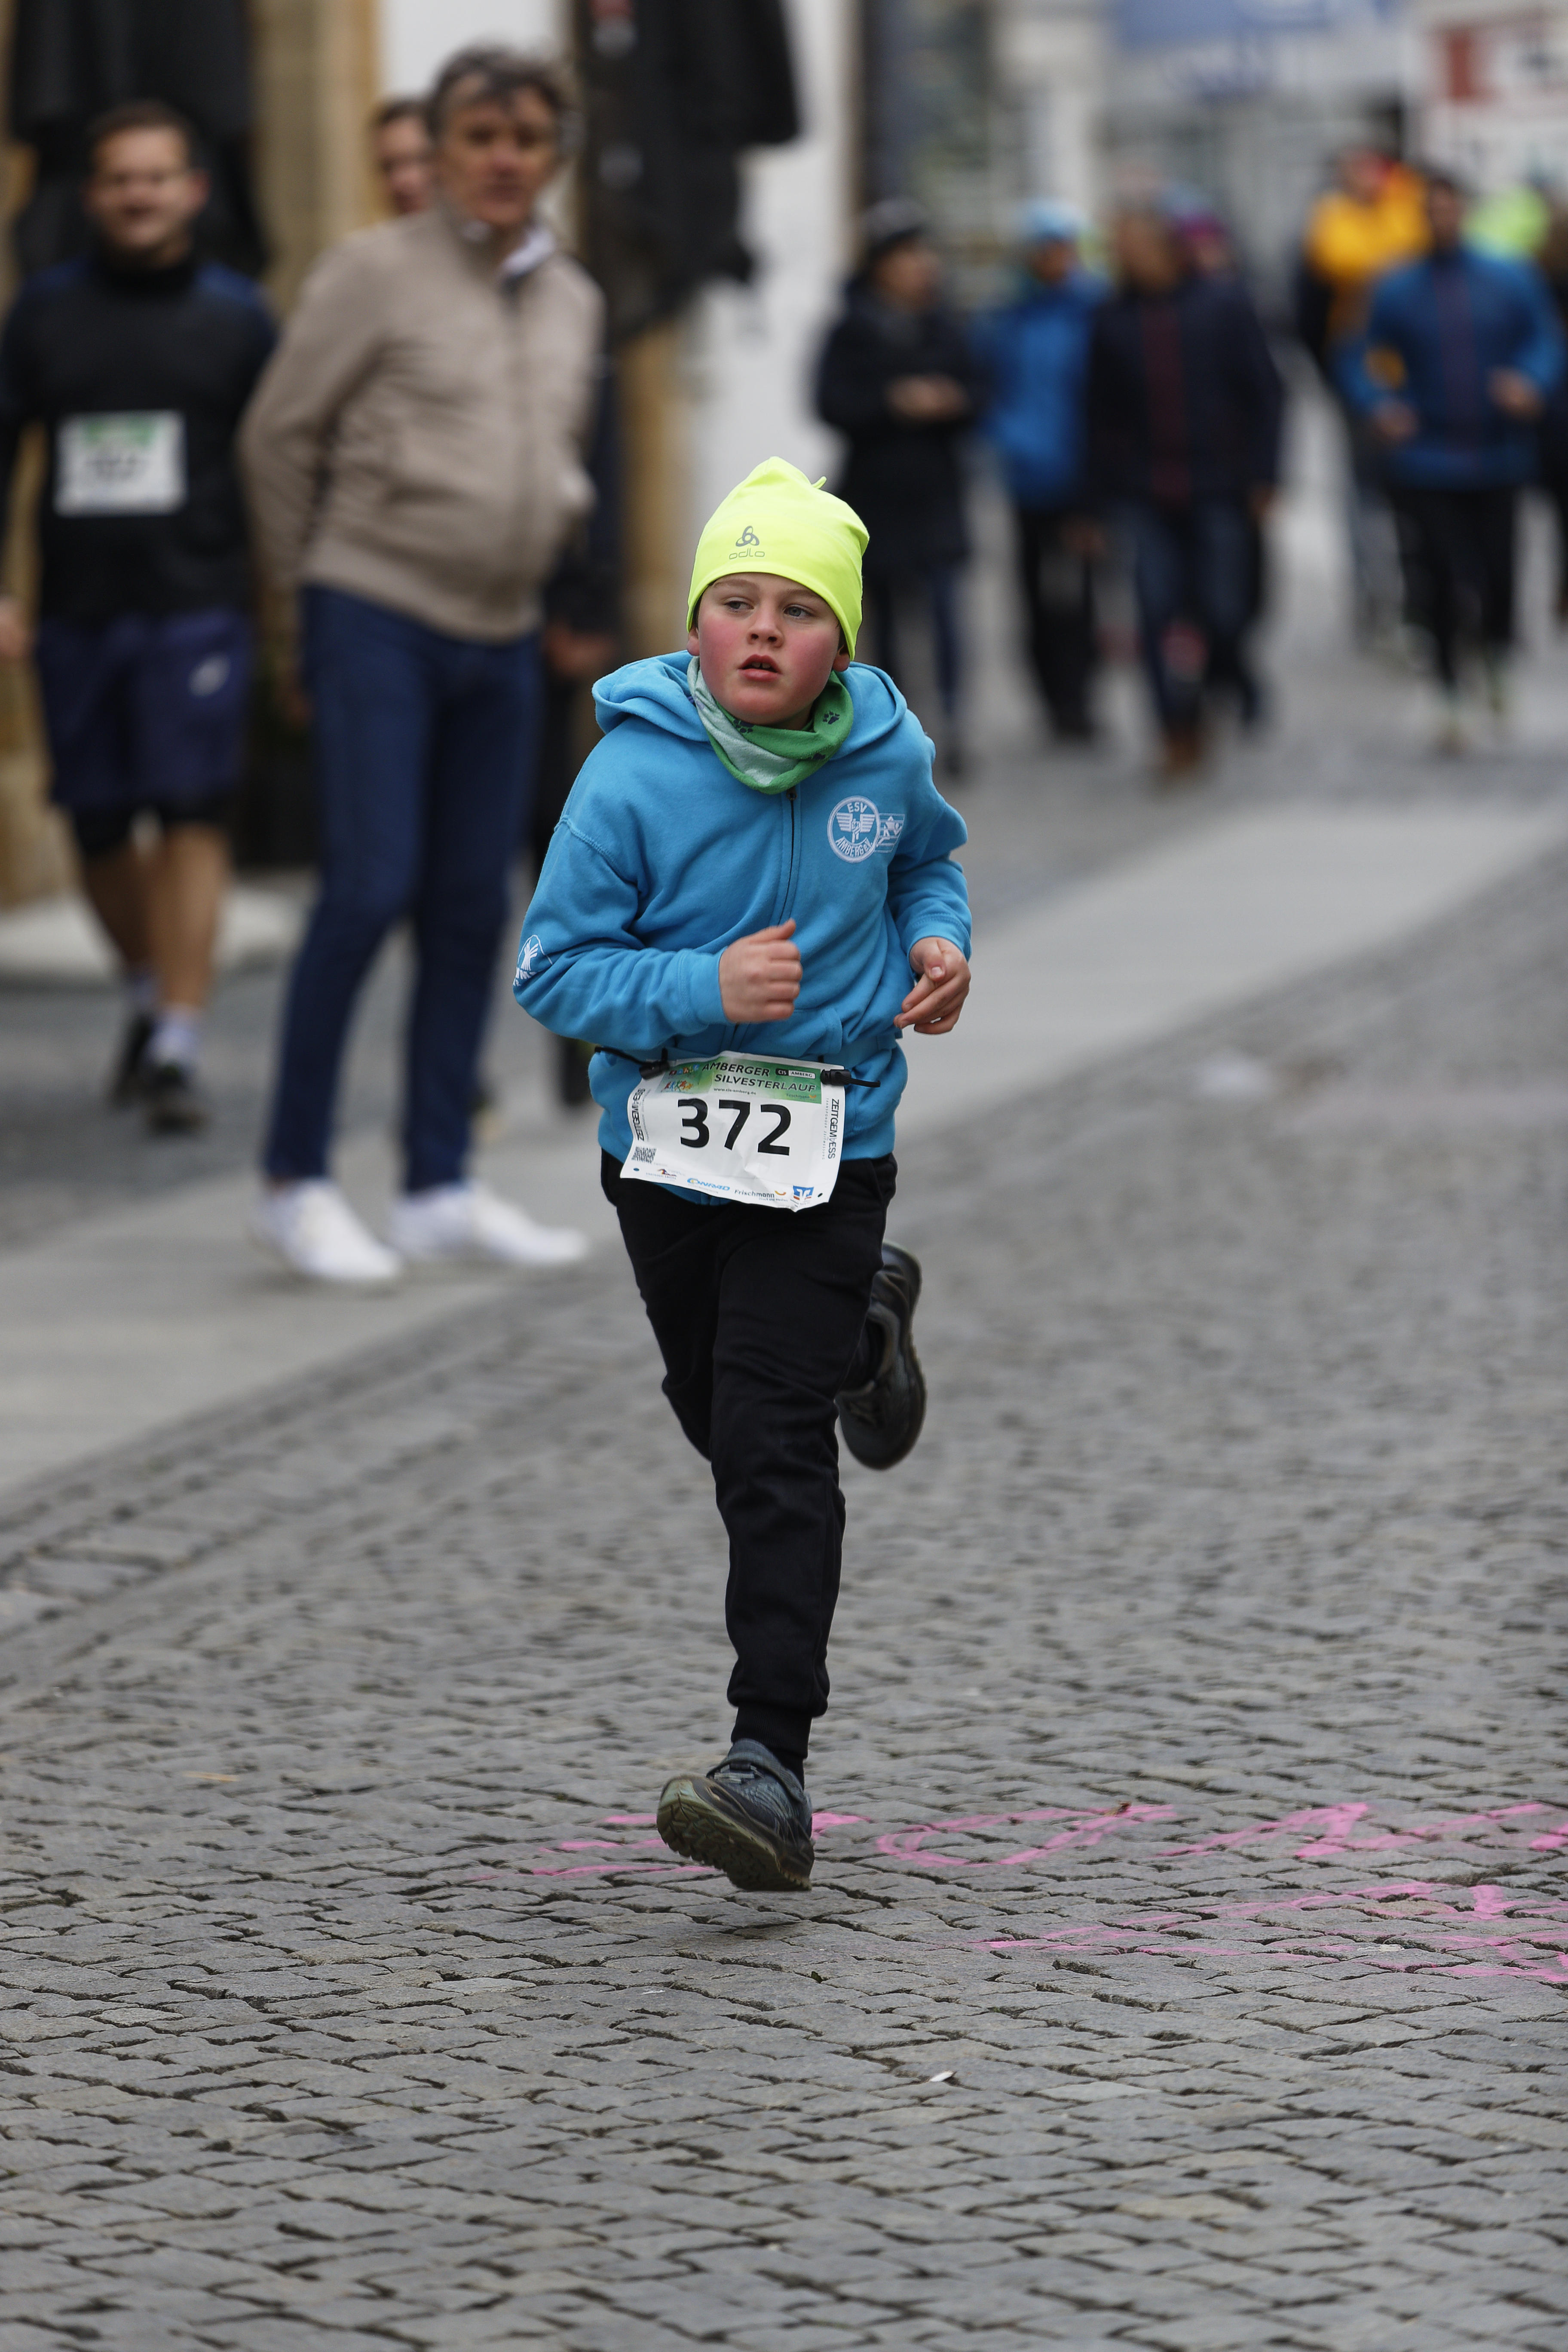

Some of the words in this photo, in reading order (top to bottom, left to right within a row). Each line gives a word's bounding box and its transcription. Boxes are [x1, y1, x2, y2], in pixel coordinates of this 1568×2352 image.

[729, 548, 765, 560] odlo
[847, 802, 867, 813] ESV
[835, 836, 864, 858] AMBERG
[702, 1062, 771, 1077] AMBERGER
[714, 1074, 817, 1093] SILVESTERLAUF
[677, 1097, 791, 1156] 372
[734, 1189, 775, 1198] Frischmann
